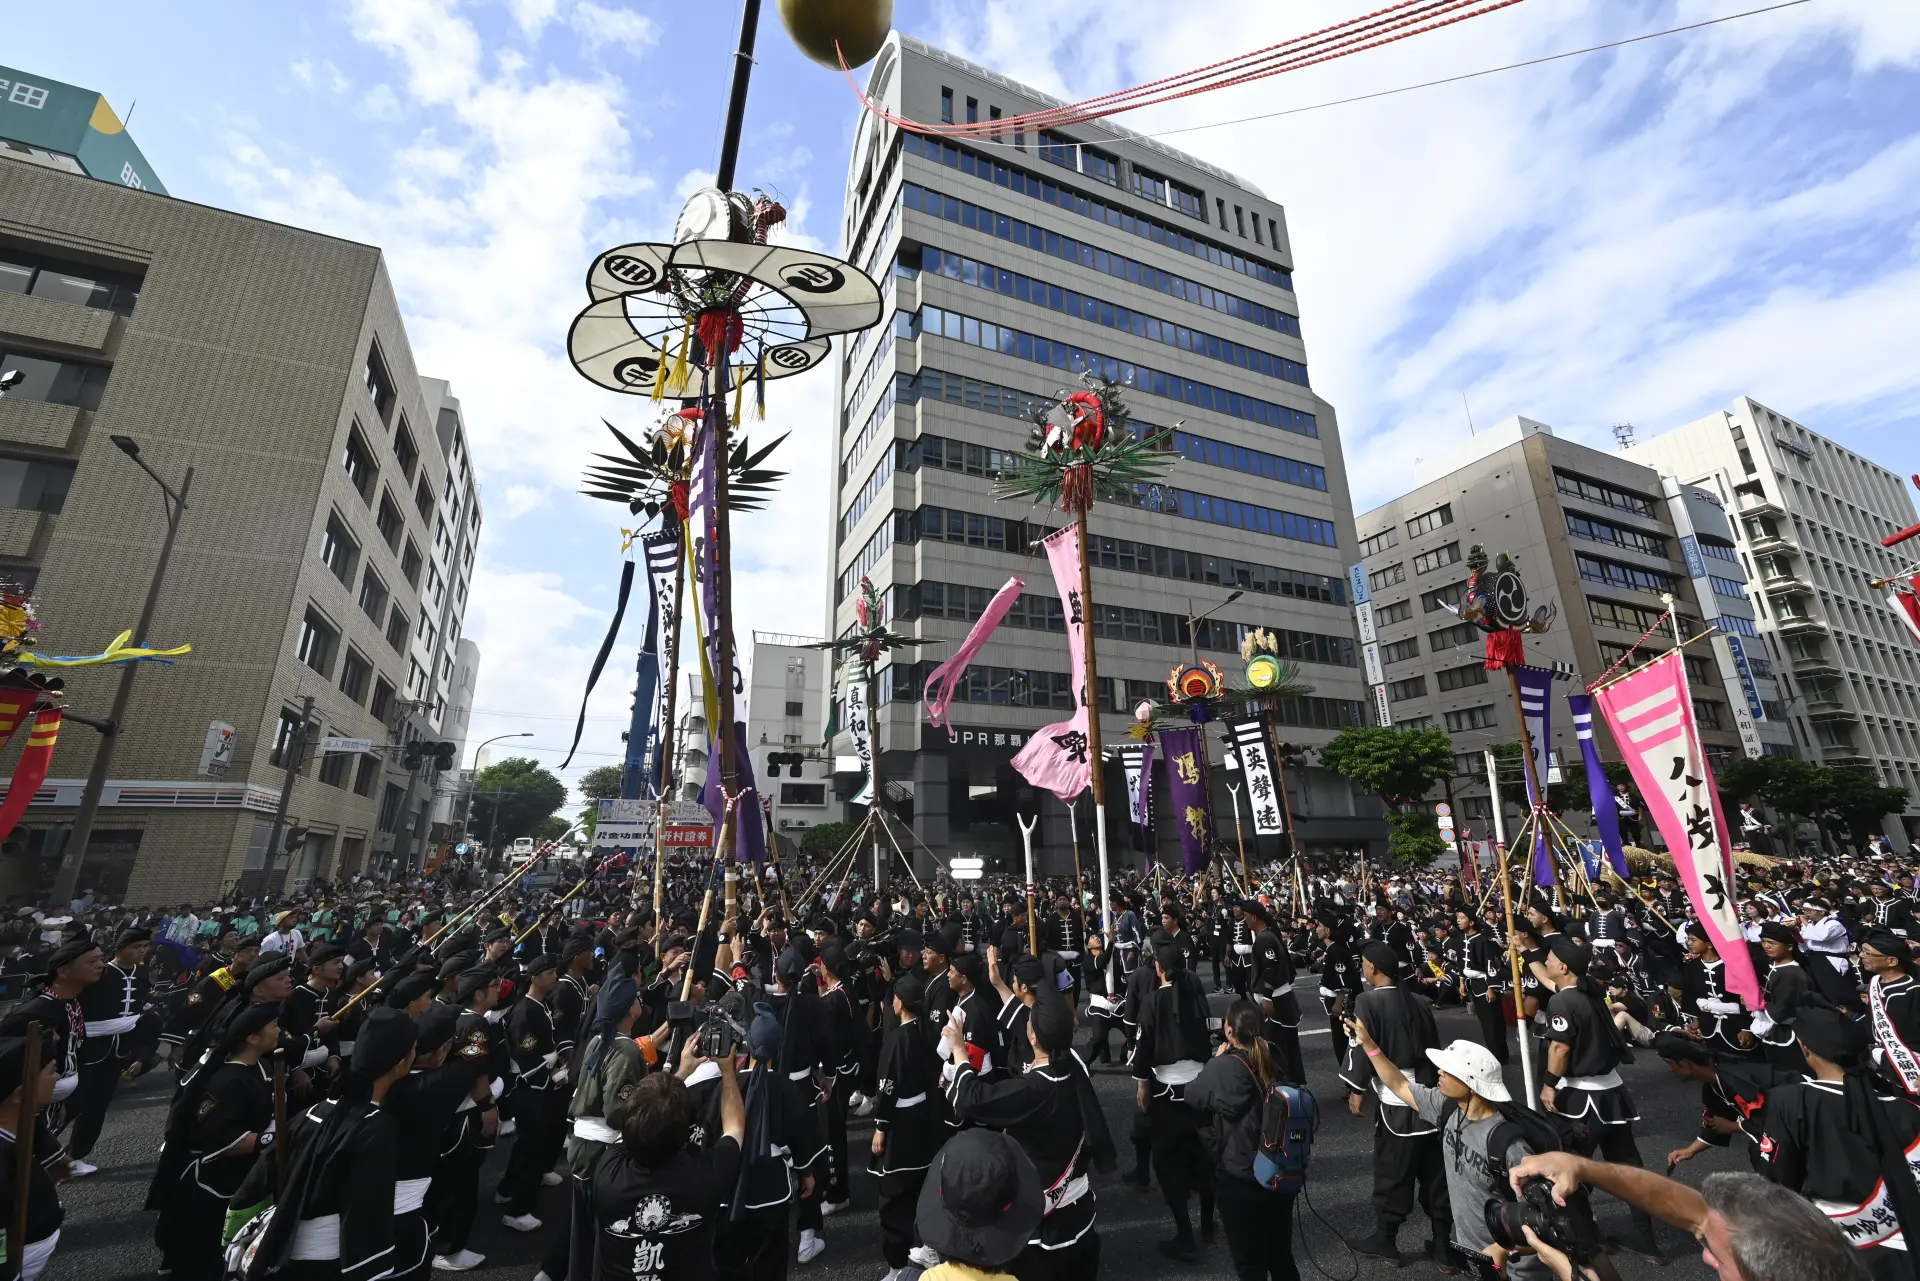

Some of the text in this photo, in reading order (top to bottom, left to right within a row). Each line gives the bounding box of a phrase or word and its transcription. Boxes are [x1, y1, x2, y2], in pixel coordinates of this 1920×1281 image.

[1353, 566, 1364, 601] KUMON
[949, 731, 1032, 747] JPR那覇
[1736, 708, 1760, 756] 大和証券
